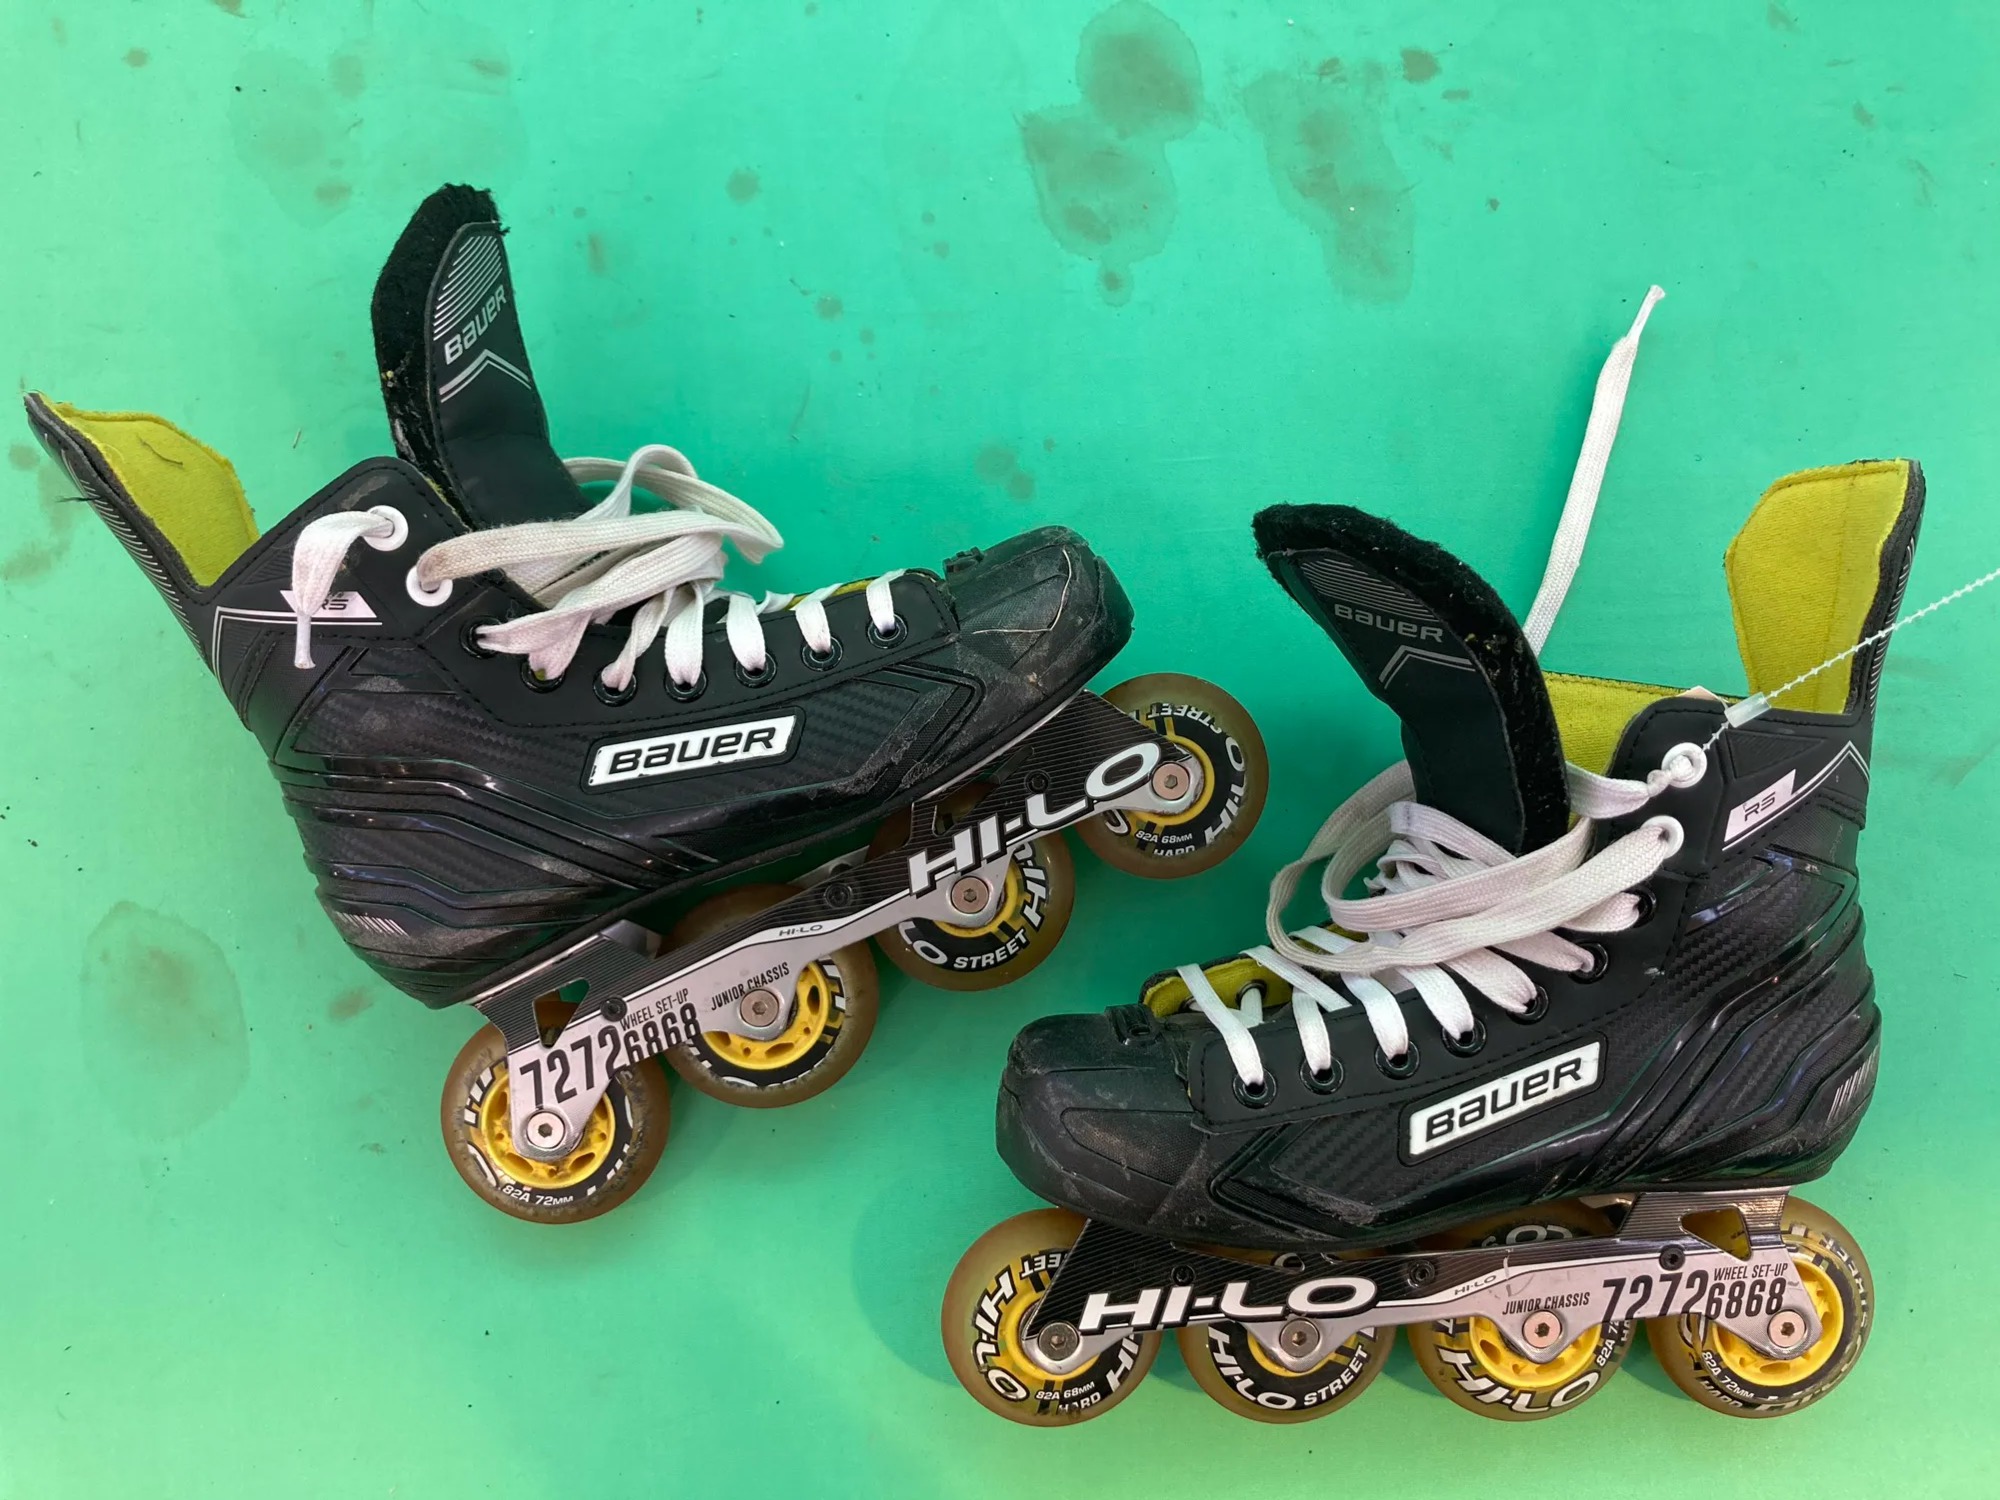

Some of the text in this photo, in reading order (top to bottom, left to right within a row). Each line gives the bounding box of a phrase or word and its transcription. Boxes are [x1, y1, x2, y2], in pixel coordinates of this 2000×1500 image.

[1334, 603, 1443, 643] BAUER
[608, 727, 776, 775] BAUER
[908, 743, 1160, 894] HI-LO
[1744, 791, 1776, 822] RS
[1135, 830, 1193, 844] 82A 68MM
[778, 924, 823, 937] HI-LO
[953, 928, 1028, 969] STREET
[711, 983, 746, 1011] JUNIOR
[747, 961, 790, 990] CHASSIS
[619, 988, 689, 1032] WHEEL SET-UP
[1426, 1057, 1582, 1142] BAUER
[502, 1183, 574, 1207] 82A 72MM
[1454, 1275, 1496, 1295] HI-LO
[1714, 1263, 1788, 1281] WHEEL SET-UP
[1078, 1277, 1376, 1331] HI-LO
[1502, 1292, 1590, 1315] JUNIOR CHASSIS
[972, 1270, 1029, 1400] HI-LO
[1596, 1339, 1616, 1366] 82A
[1208, 1326, 1296, 1409] HI-LO
[1304, 1345, 1368, 1406] STREET
[1438, 1348, 1599, 1412] HI-LO
[1701, 1351, 1755, 1398] 82A 72MM
[1036, 1381, 1095, 1400] 82A 68MM
